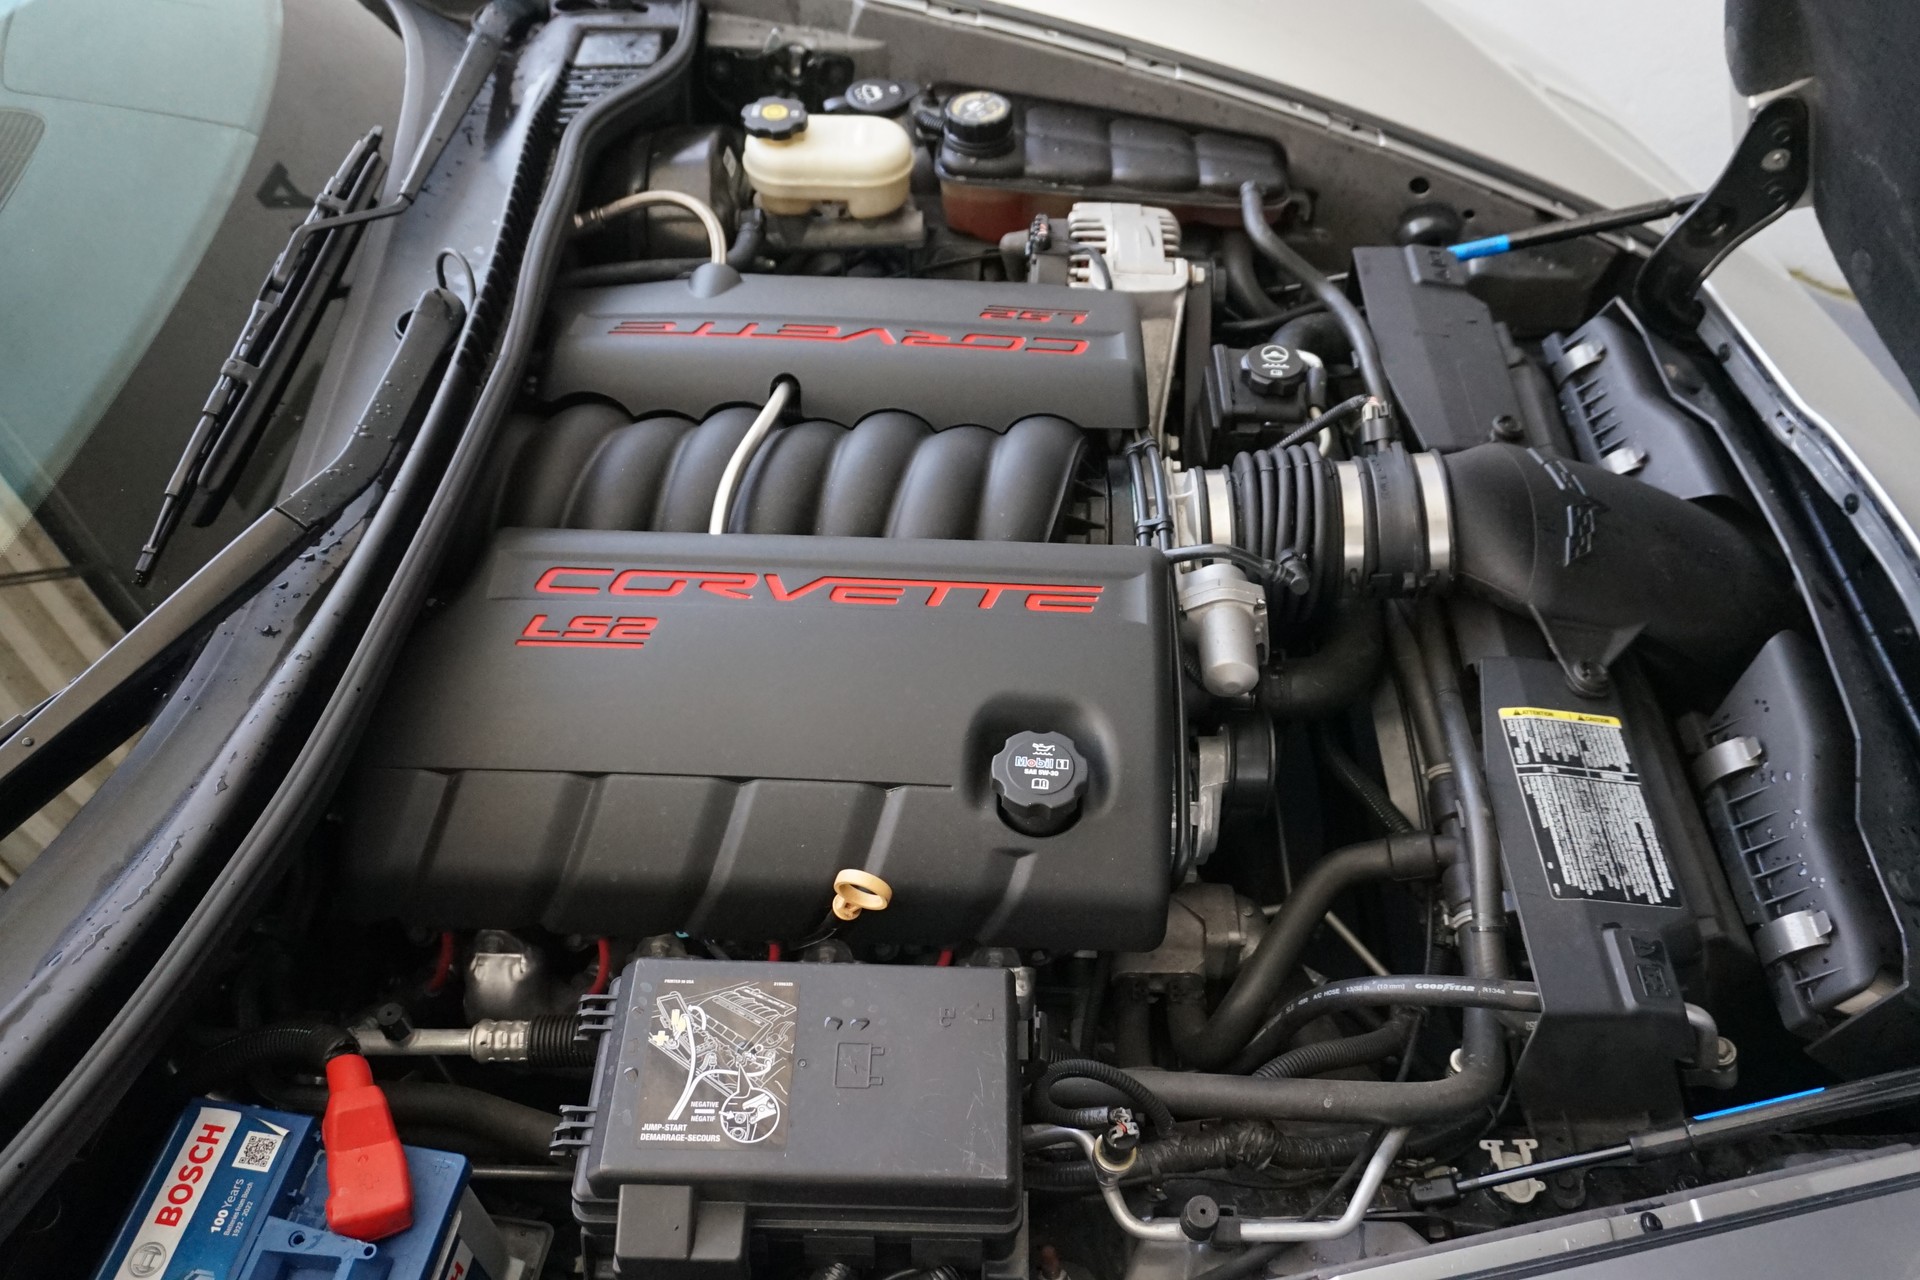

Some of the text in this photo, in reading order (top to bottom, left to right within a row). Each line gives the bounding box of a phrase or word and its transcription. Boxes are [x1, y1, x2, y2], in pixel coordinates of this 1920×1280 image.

[979, 305, 1090, 326] LS2
[608, 320, 1090, 356] CORVETTE
[534, 567, 1104, 613] CORVETTE
[519, 614, 659, 642] LS2
[1015, 756, 1054, 769] Mobil
[1038, 769, 1059, 777] 5W-30
[1415, 982, 1476, 992] GOODYEAR
[640, 1133, 721, 1143] DEMARRAGE-SECOURS
[641, 1123, 688, 1132] JUMP-START
[154, 1123, 226, 1227] BOSCH
[211, 1178, 245, 1233] 100 Years
[232, 1221, 244, 1237] 1922
[242, 1201, 254, 1217] 2022
